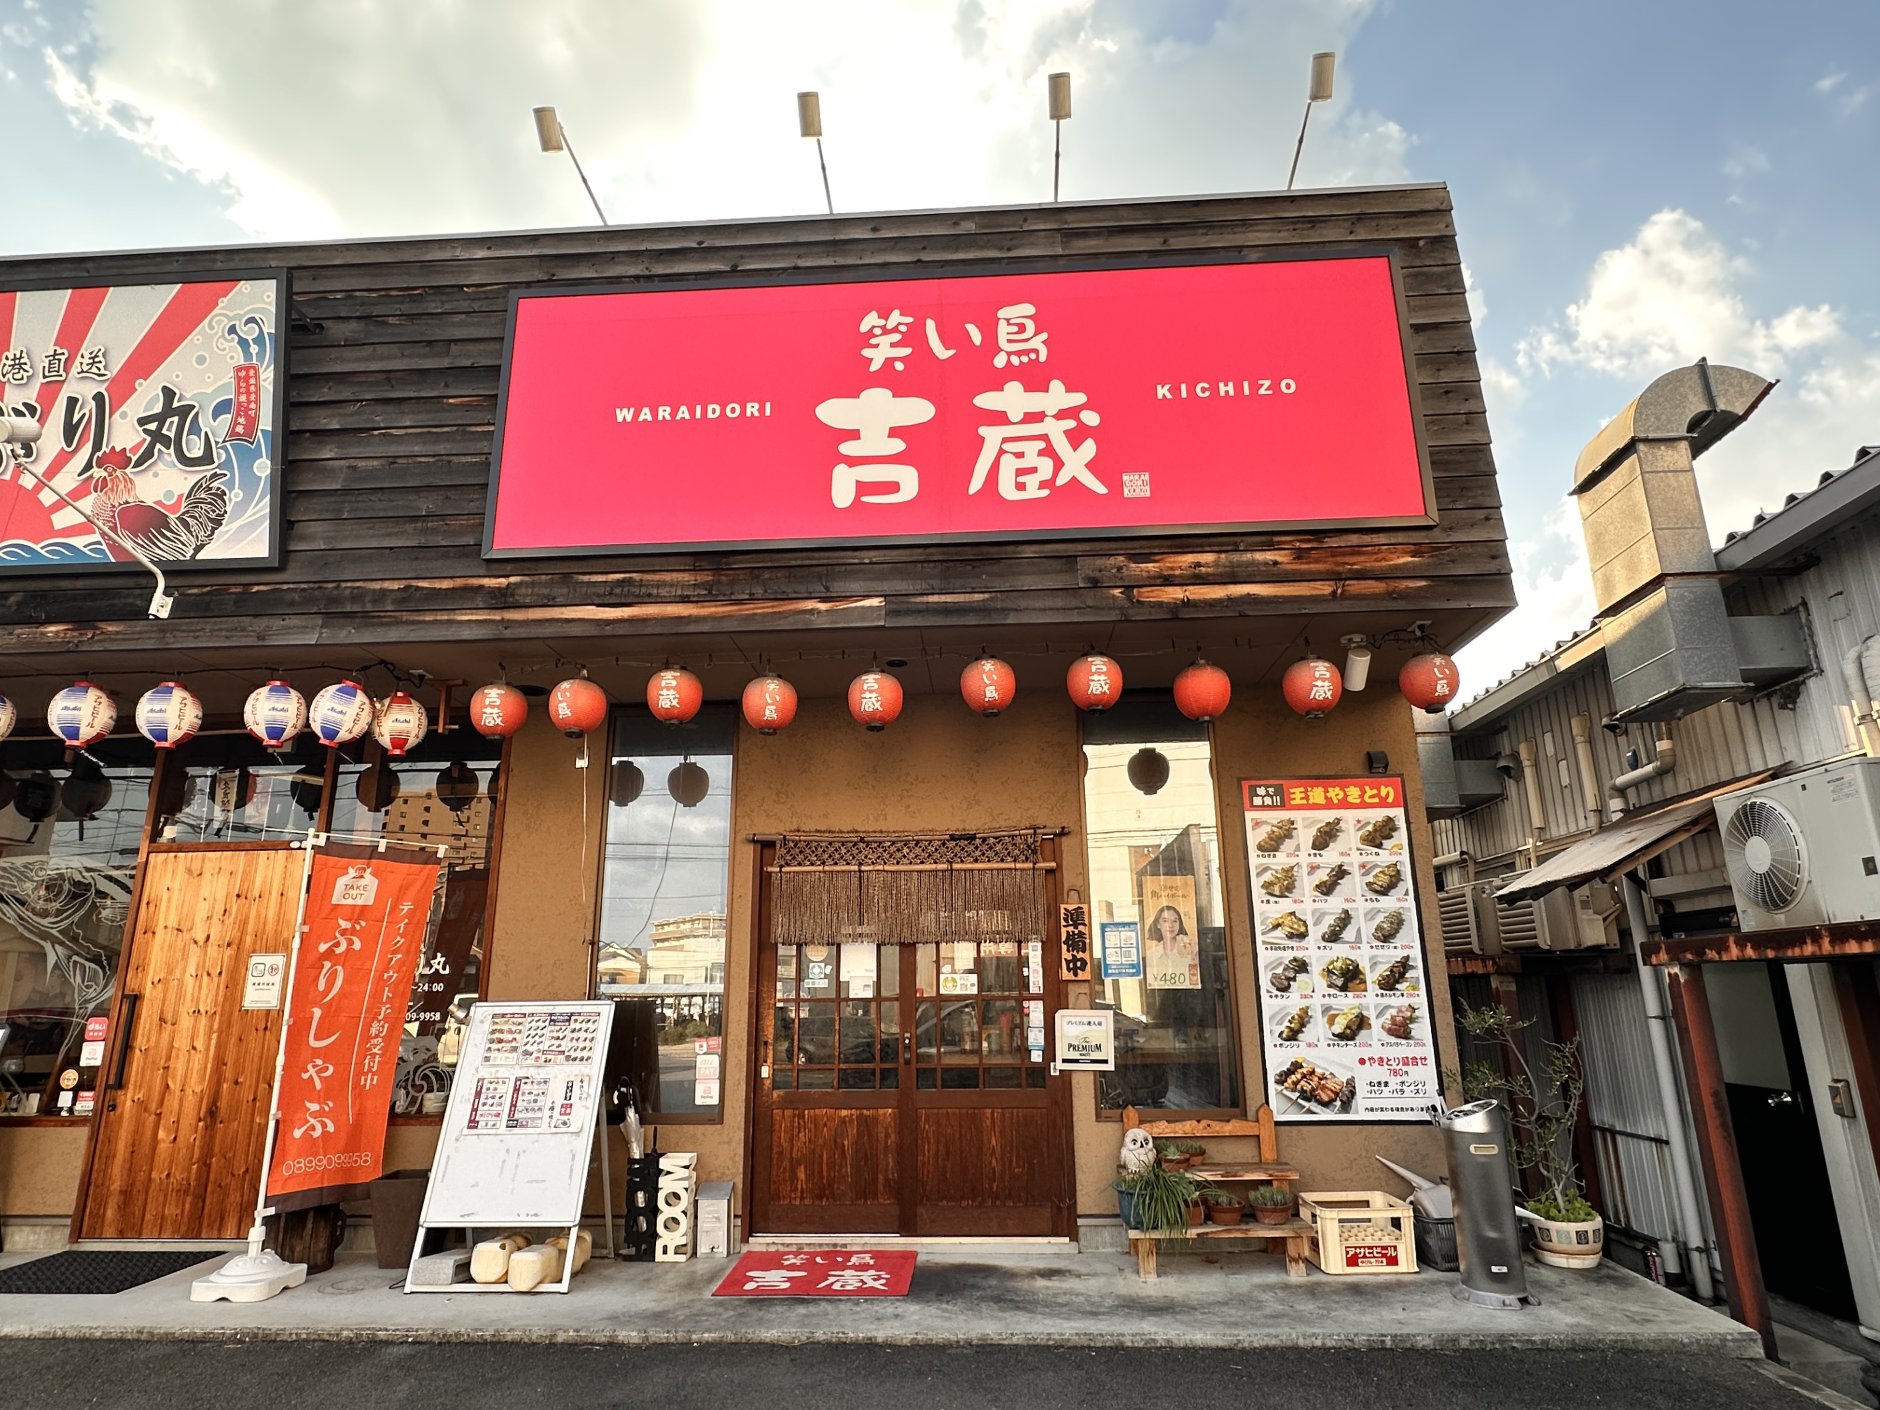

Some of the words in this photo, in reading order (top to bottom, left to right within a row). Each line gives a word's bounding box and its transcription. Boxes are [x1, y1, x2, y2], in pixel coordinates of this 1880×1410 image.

[860, 303, 1049, 372] 笑い鳥
[0, 348, 111, 383] 港直送
[1156, 378, 1299, 399] KICHIZO
[615, 401, 774, 423] WARAIDORI
[0, 388, 217, 477] り丸
[814, 379, 1108, 509] 吉蔵
[658, 671, 681, 709] 吉蔵
[860, 674, 882, 713] 吉蔵
[980, 658, 999, 702] 笑い鳥
[1086, 655, 1111, 696] 吉蔵
[1309, 661, 1334, 701] 吉蔵
[1432, 655, 1452, 697] 笑い鳥
[268, 705, 289, 713] Asahi
[327, 706, 348, 716] Asahi
[481, 688, 504, 727] 吉蔵
[556, 681, 573, 720] 笑い鳥
[763, 679, 780, 721] 笑い鳥
[391, 717, 411, 725] Asahi
[1288, 785, 1396, 805] 王道やきとり
[342, 892, 366, 901] OUT
[343, 883, 369, 893] TAKE
[1063, 905, 1088, 978] 準備中
[360, 901, 415, 1091] テイクアウト予約受付中
[1067, 1043, 1102, 1052] PREMIUM
[1367, 1056, 1428, 1067] やきとり盛合せ
[1387, 1068, 1409, 1077] 780円
[655, 1152, 697, 1263] ROOM
[780, 1253, 876, 1265] 笑い鳥
[1345, 1246, 1397, 1257] アサヒビール
[742, 1269, 891, 1290] 吉蔵
